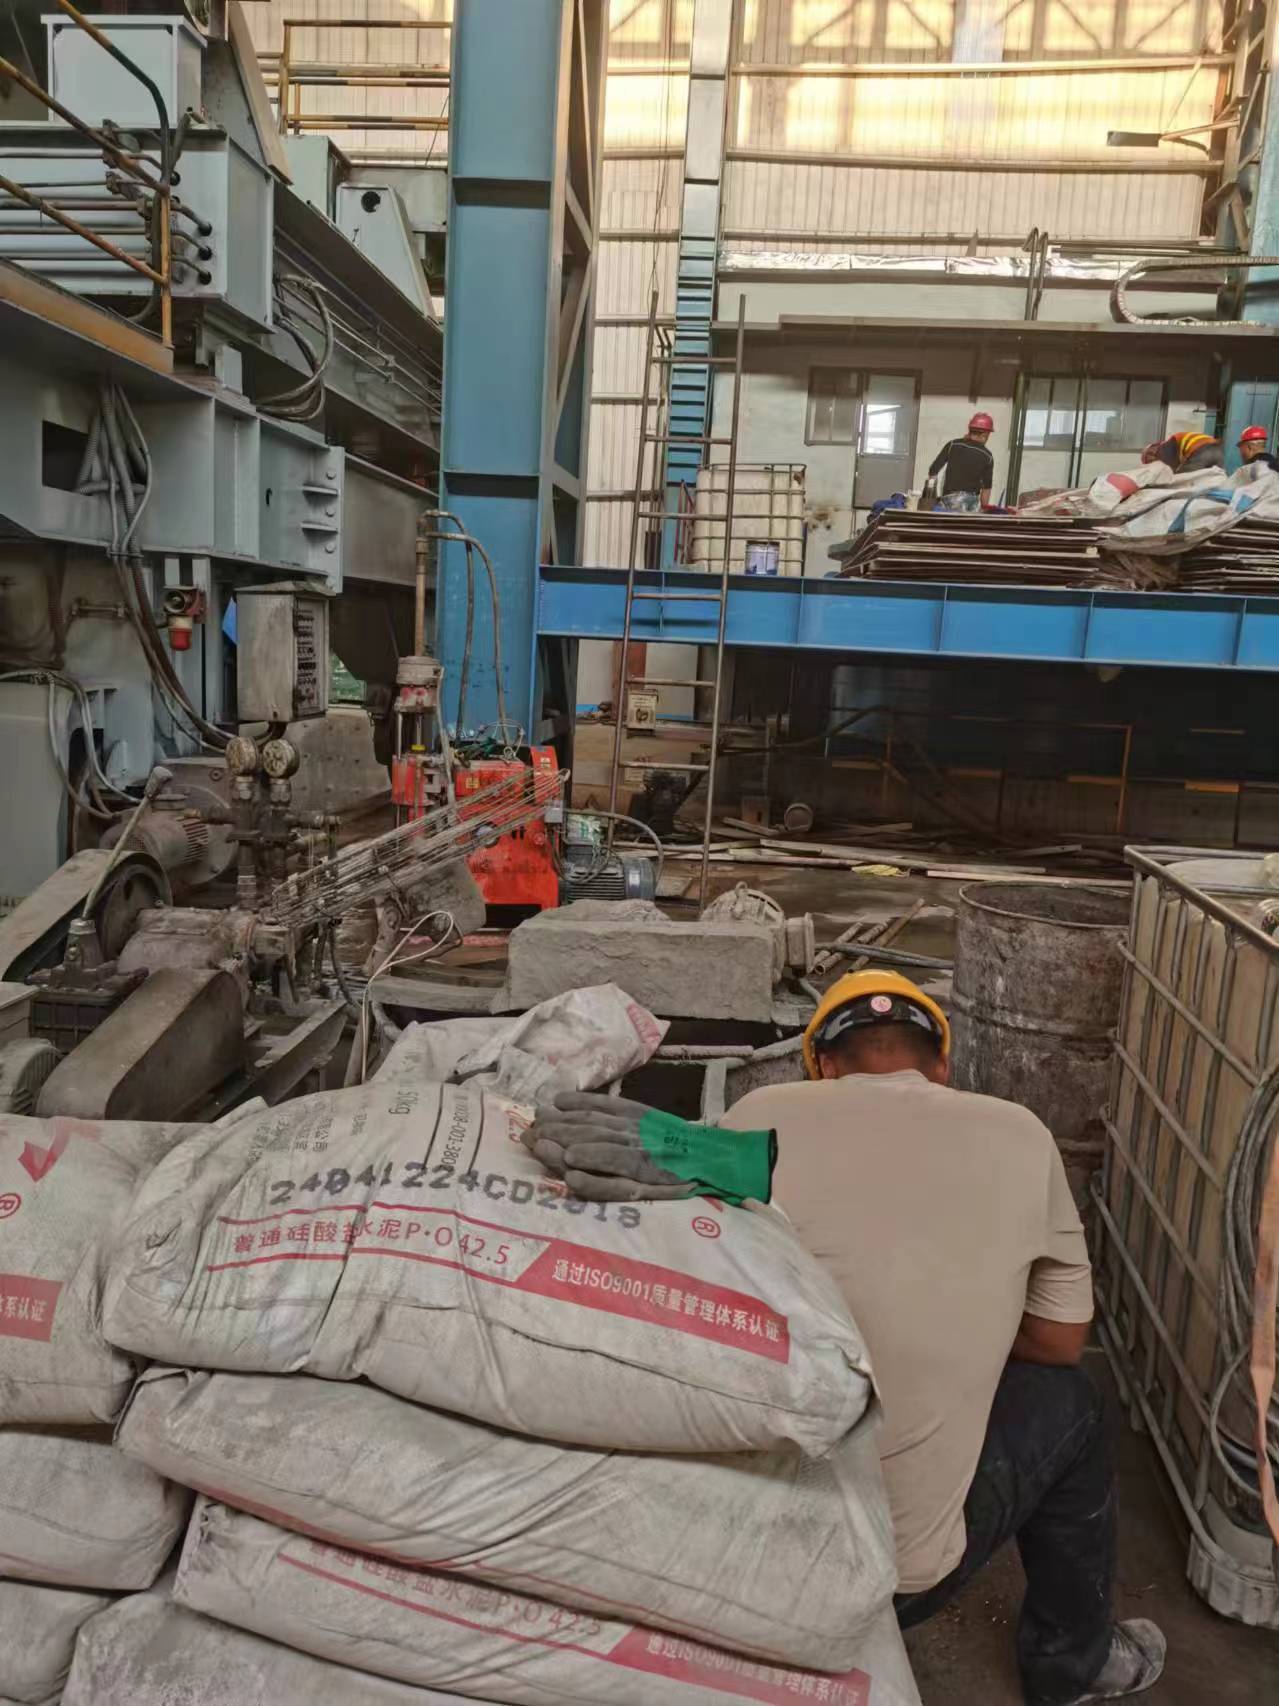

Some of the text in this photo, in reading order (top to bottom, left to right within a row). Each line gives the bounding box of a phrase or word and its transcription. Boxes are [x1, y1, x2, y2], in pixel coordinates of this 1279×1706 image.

[551, 1258, 780, 1342] 通过ISO9001质量管理体系认证
